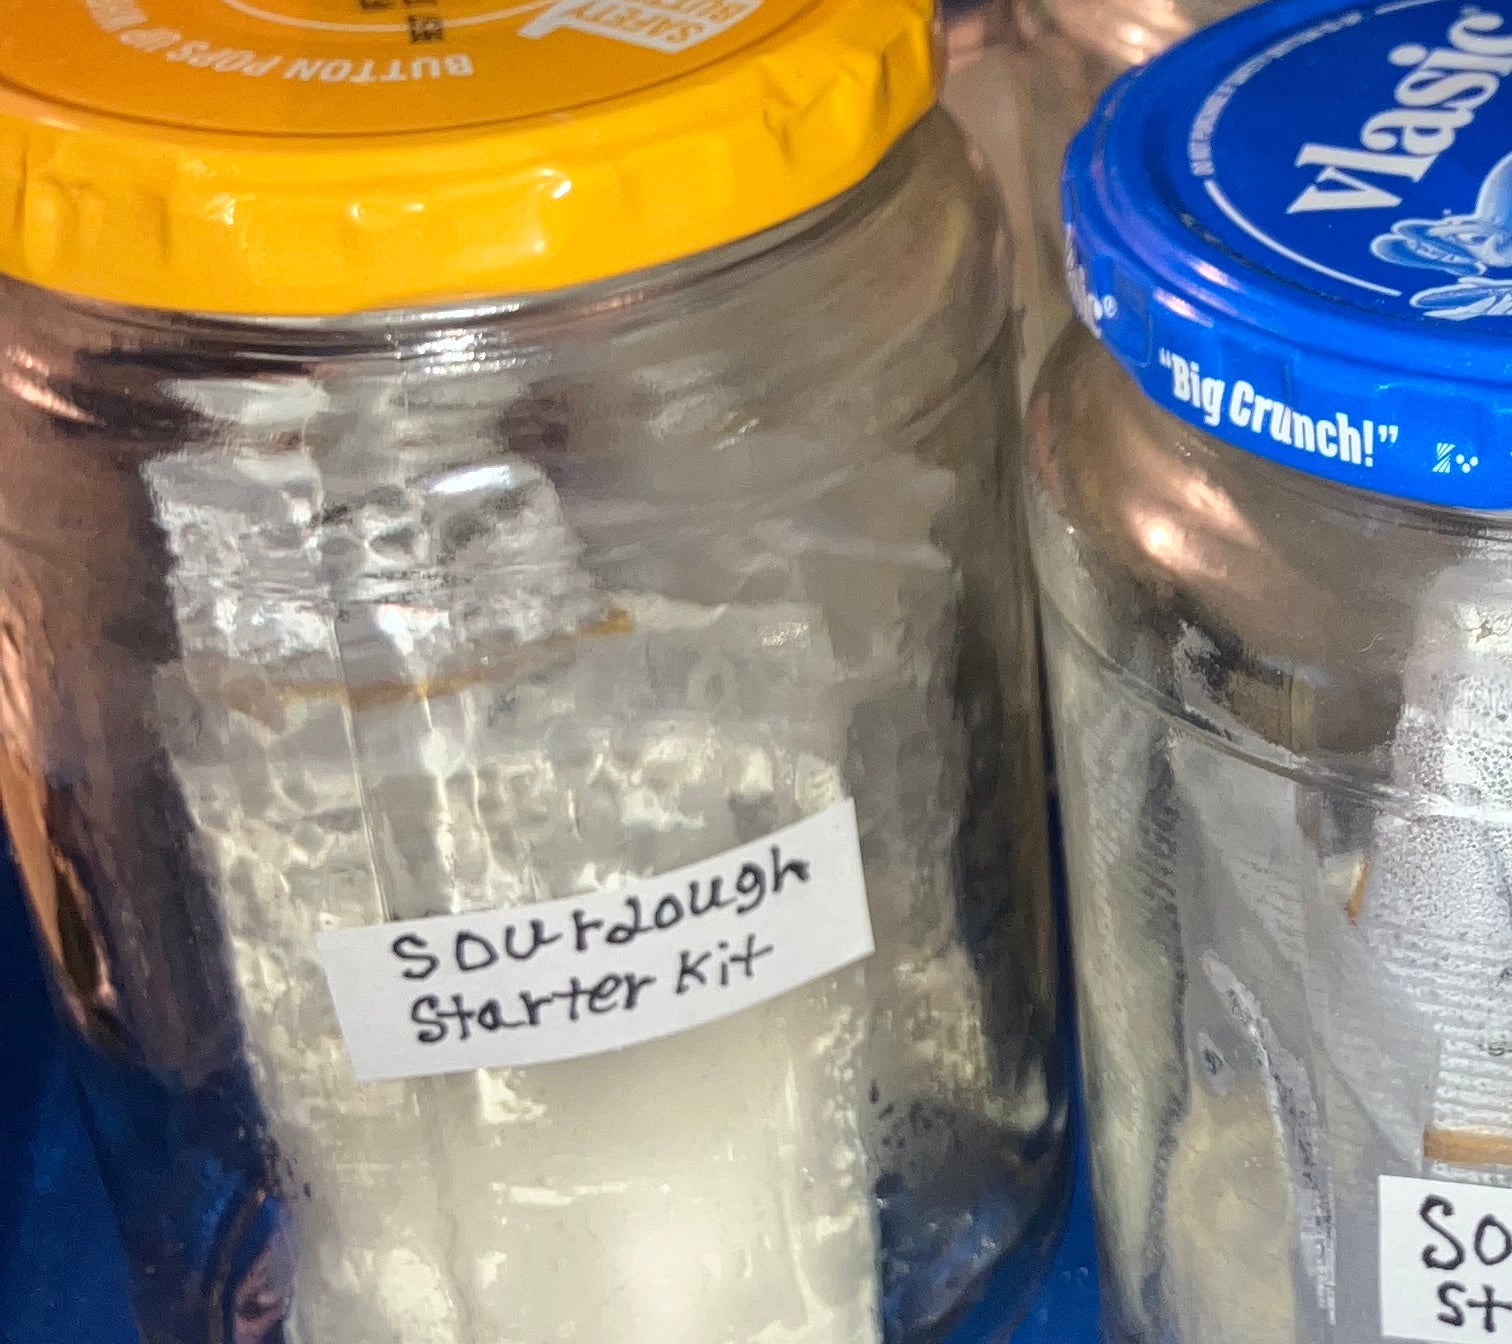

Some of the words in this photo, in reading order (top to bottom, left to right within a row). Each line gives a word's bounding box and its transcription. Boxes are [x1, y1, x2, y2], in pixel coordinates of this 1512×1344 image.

[283, 53, 473, 84] BUTTON
[1158, 346, 1226, 428] “Big
[1228, 379, 1399, 468] Crunch!”
[392, 844, 810, 981] Sourdough
[409, 968, 657, 1046] Starter
[676, 934, 774, 996] Kit
